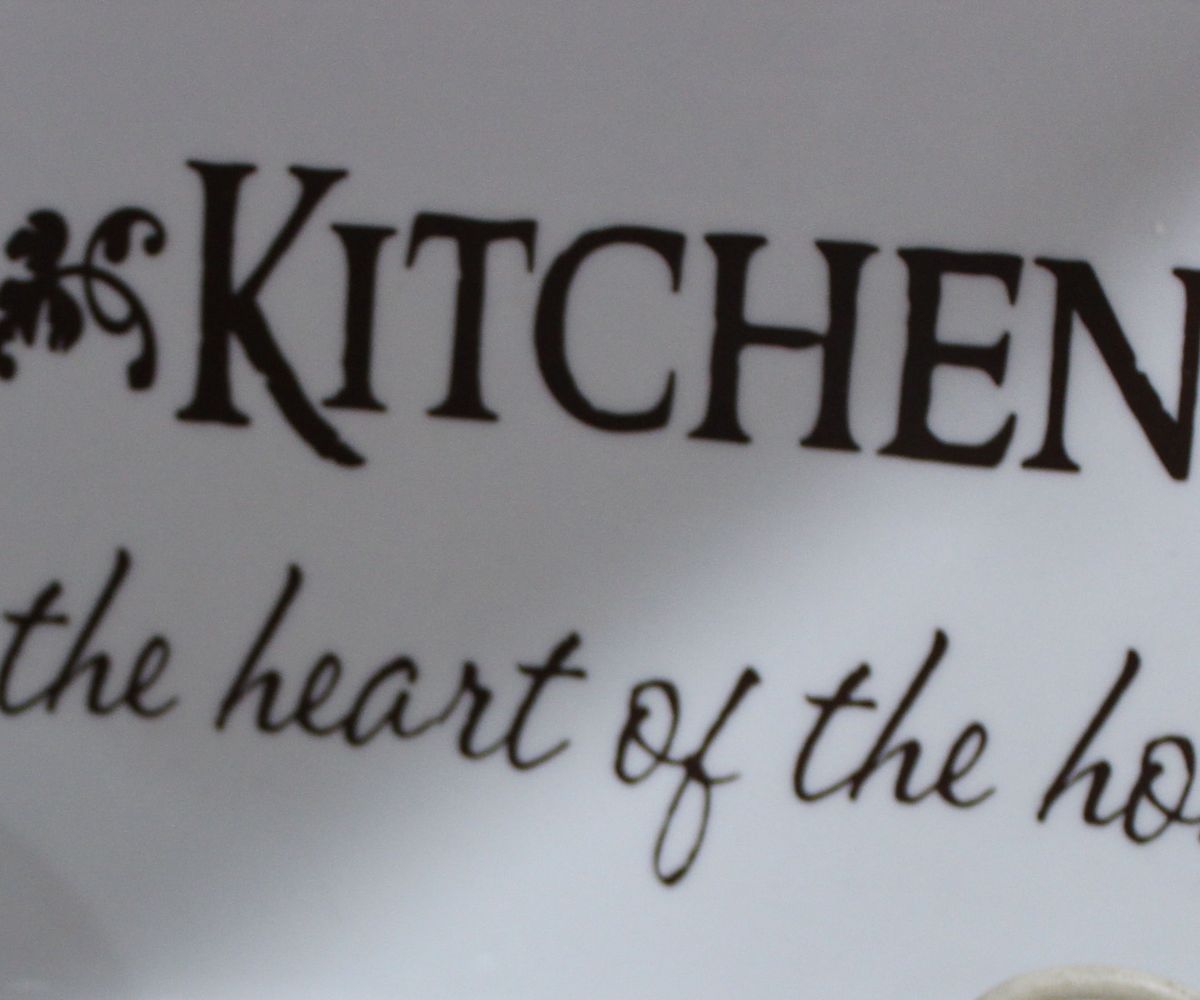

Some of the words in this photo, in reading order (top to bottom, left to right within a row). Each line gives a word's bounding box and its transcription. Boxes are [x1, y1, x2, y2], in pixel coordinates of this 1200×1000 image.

[175, 158, 1200, 482] KITCHEN
[214, 562, 587, 770] heart
[614, 666, 762, 886] of
[793, 628, 996, 808] the
[1037, 647, 1200, 844] ho
